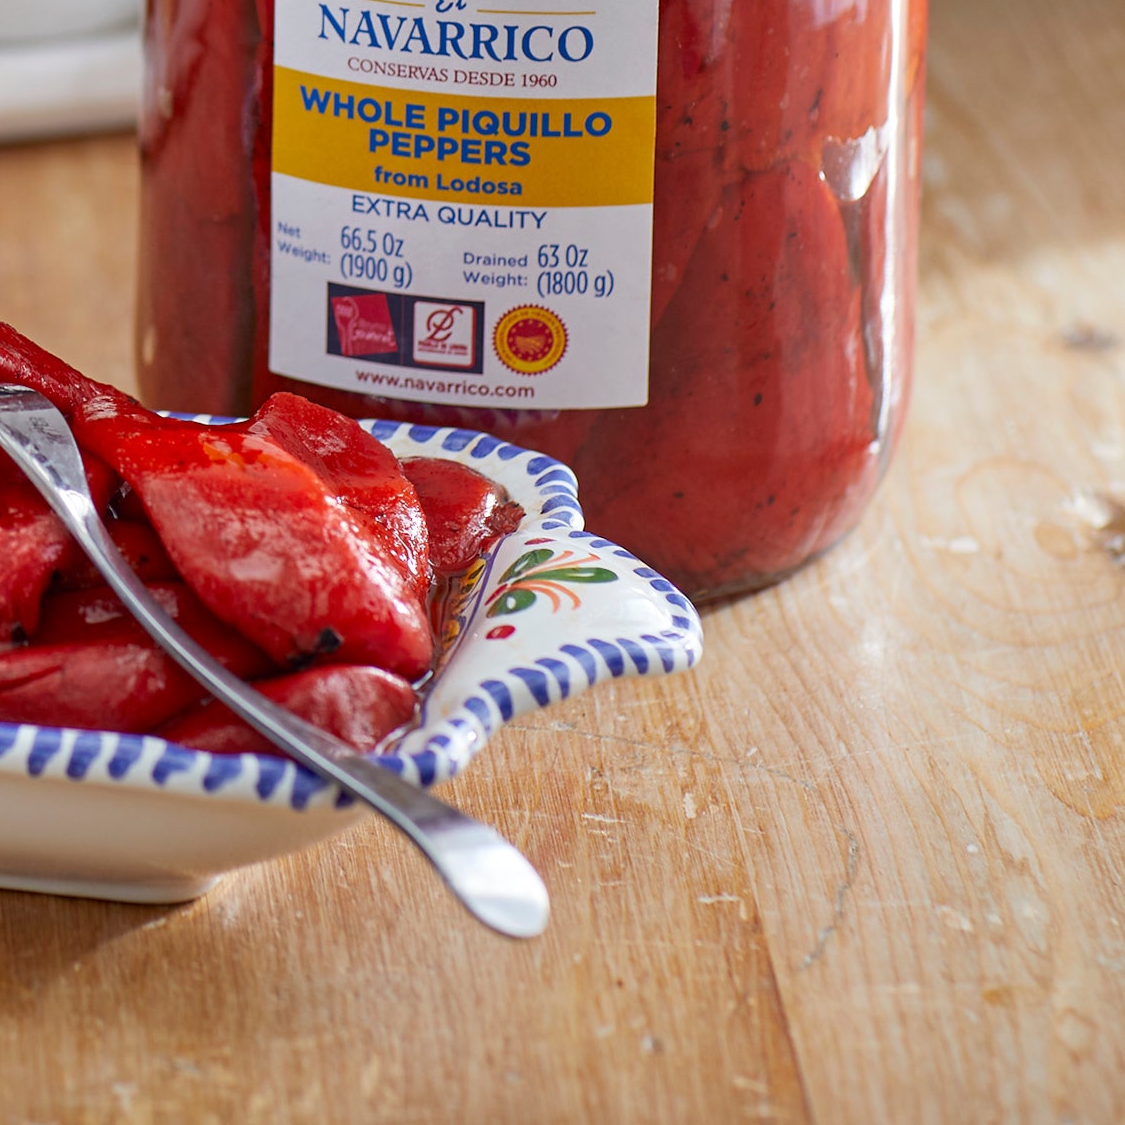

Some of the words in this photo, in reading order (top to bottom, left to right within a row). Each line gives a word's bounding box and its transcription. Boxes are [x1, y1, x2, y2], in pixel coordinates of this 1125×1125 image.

[318, 3, 594, 63] NAVARRICO
[347, 56, 448, 83] CONSERVAS
[454, 69, 516, 88] DESDE
[521, 73, 558, 88] 1960
[299, 85, 426, 130] WHOLE
[437, 107, 613, 138] PIQUILLO
[368, 128, 531, 167] PEPPERS
[374, 166, 429, 189] from
[436, 173, 523, 196] Lodosa
[352, 194, 430, 222] EXTRA
[437, 206, 547, 229] QUALITY
[278, 222, 301, 239] Net
[340, 226, 376, 253] 66.5
[277, 241, 332, 265] Weight:
[463, 252, 528, 267] Drained
[537, 244, 560, 268] 63
[340, 253, 388, 282] (1900
[393, 262, 413, 289] g)
[463, 271, 528, 288] Weight:
[537, 270, 588, 298] (1800
[594, 269, 615, 298] g)
[355, 369, 535, 398] www.navarrico.com
